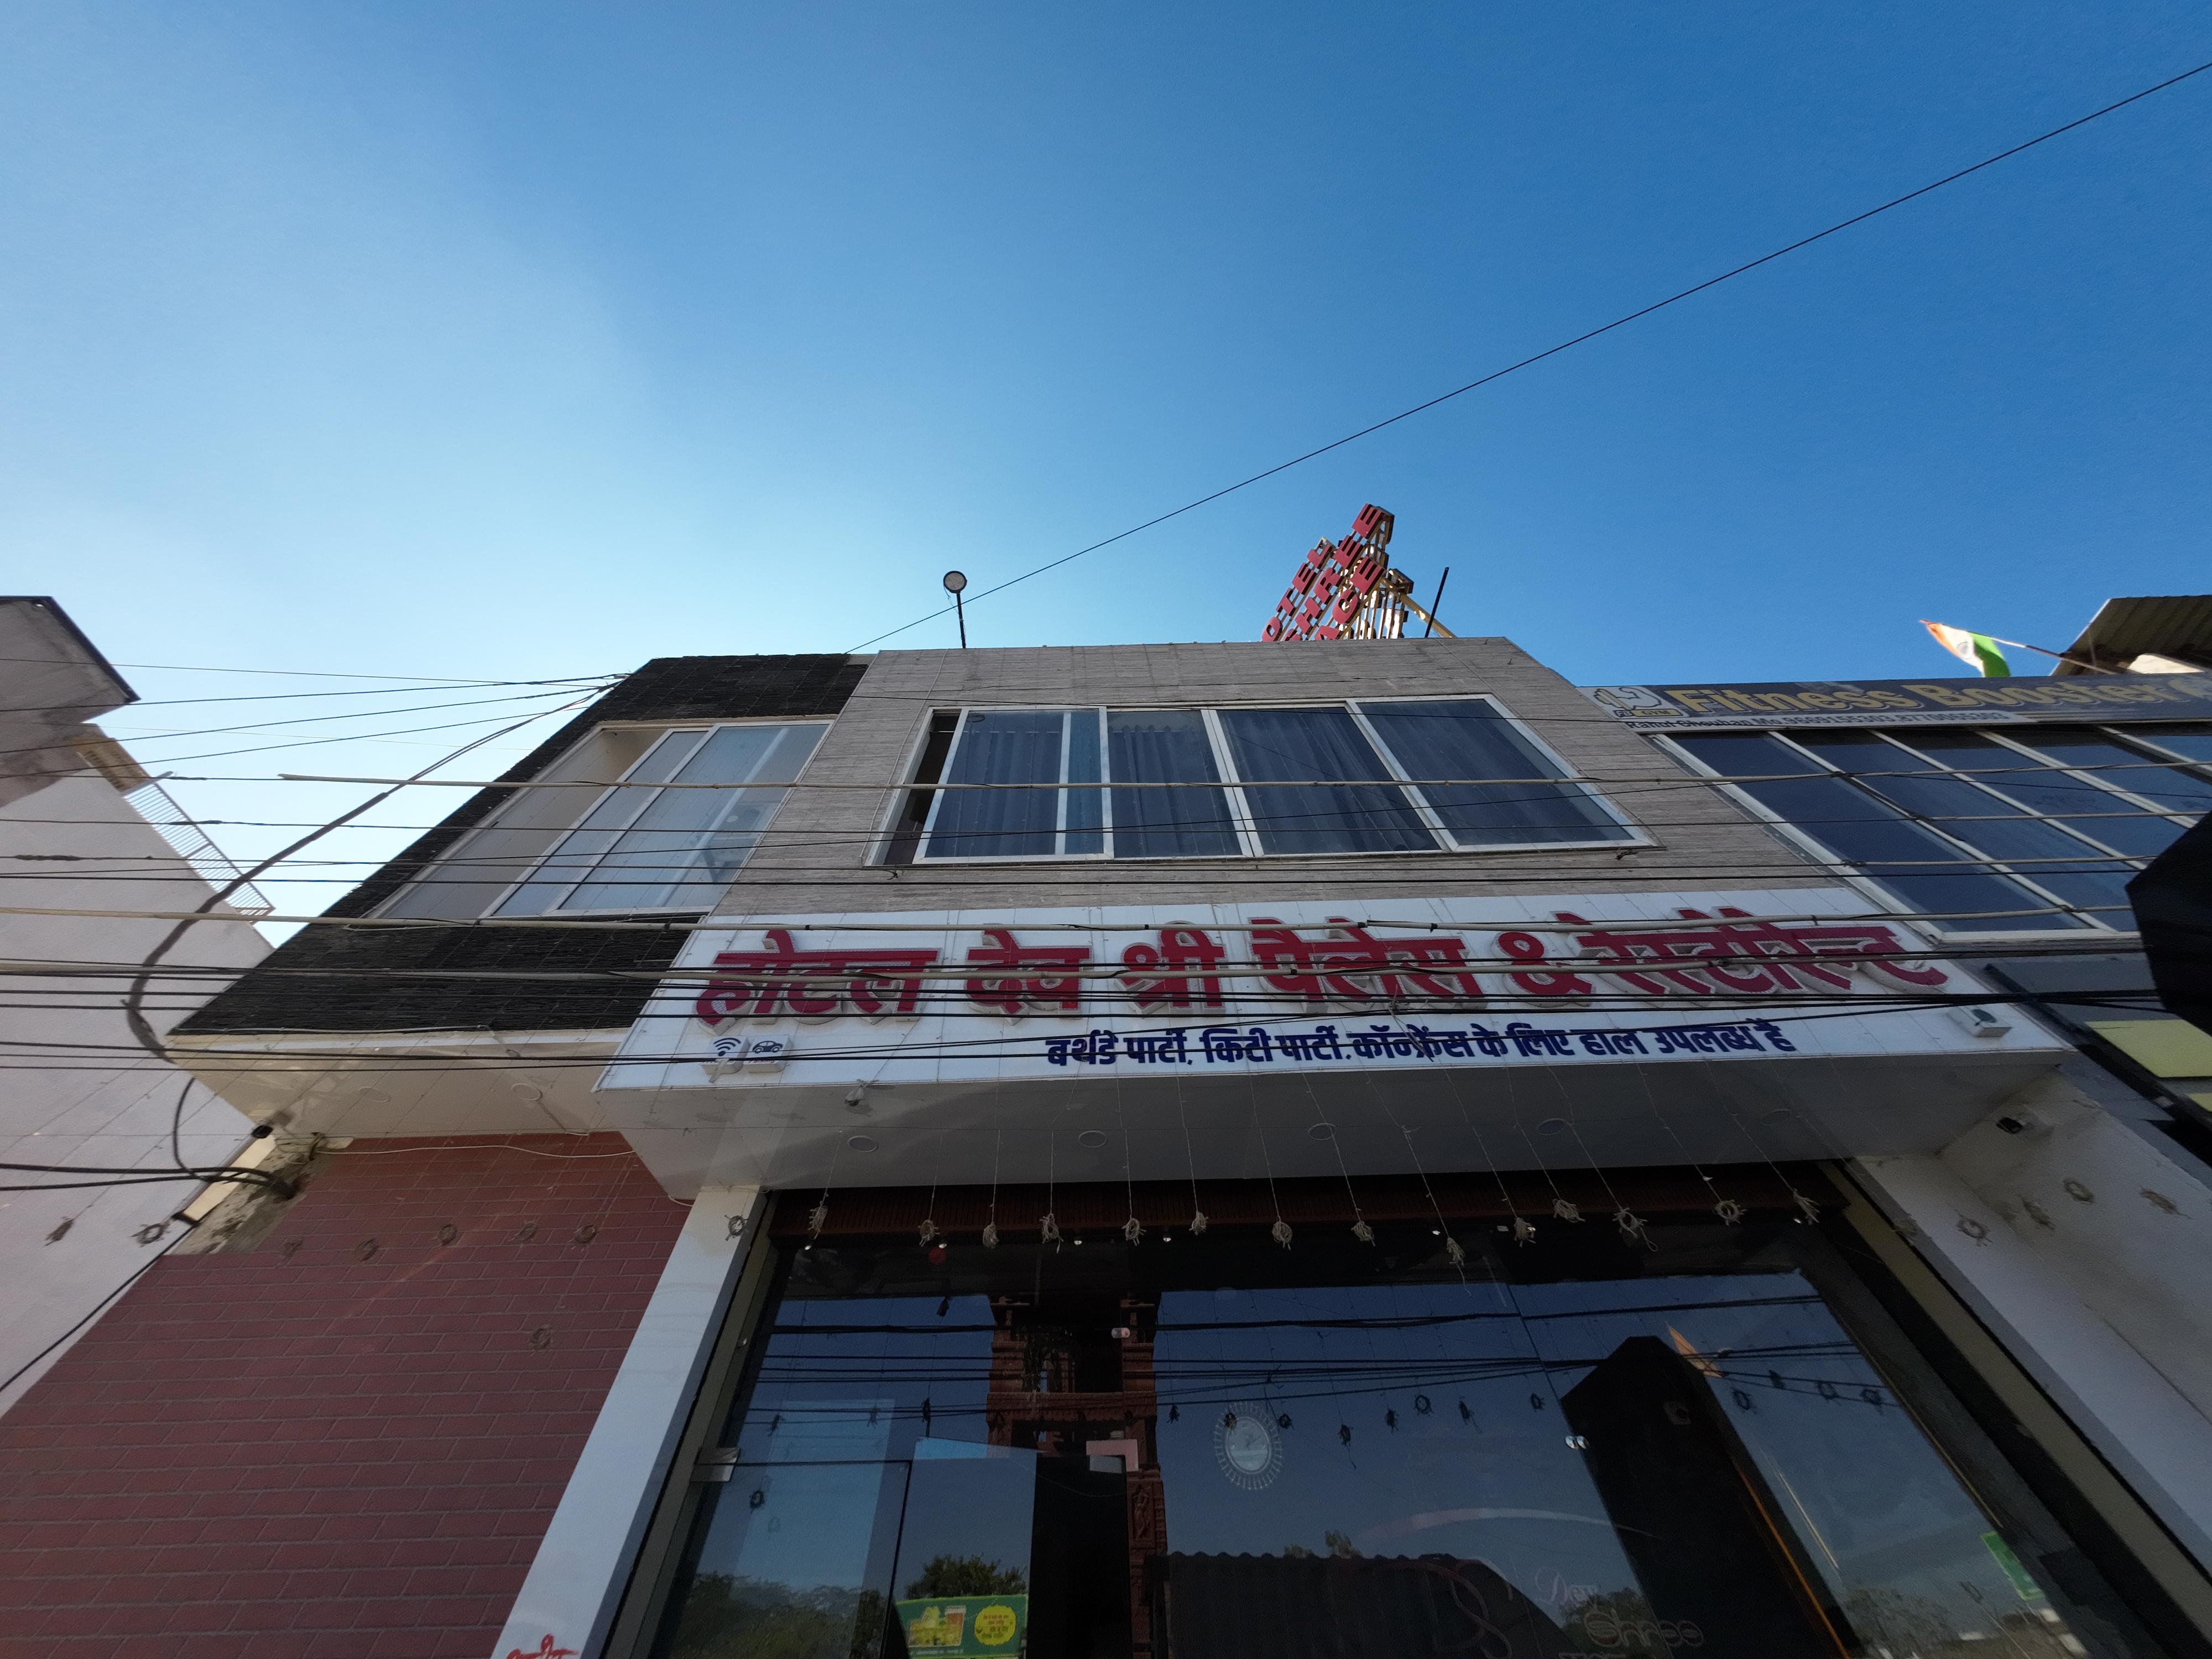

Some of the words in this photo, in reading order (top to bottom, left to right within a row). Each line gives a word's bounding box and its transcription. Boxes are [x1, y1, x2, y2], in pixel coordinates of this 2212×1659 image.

[1663, 689, 1922, 712] Fitness
[1901, 682, 2161, 707] Booster
[695, 929, 938, 1025] होटल
[966, 929, 1090, 1015] देव
[1123, 921, 1225, 1008] श्री
[1251, 916, 1483, 1002] पैलेस
[1495, 932, 1593, 995] &
[1045, 1030, 1119, 1066] बर्थडे
[1199, 1027, 1272, 1064] किटी
[1470, 1022, 1509, 1057] के
[1504, 1022, 1575, 1056] लिए
[1569, 1027, 1651, 1055] हाल
[1641, 1024, 1768, 1053] उपलब्ध
[1750, 1018, 1798, 1053] है
